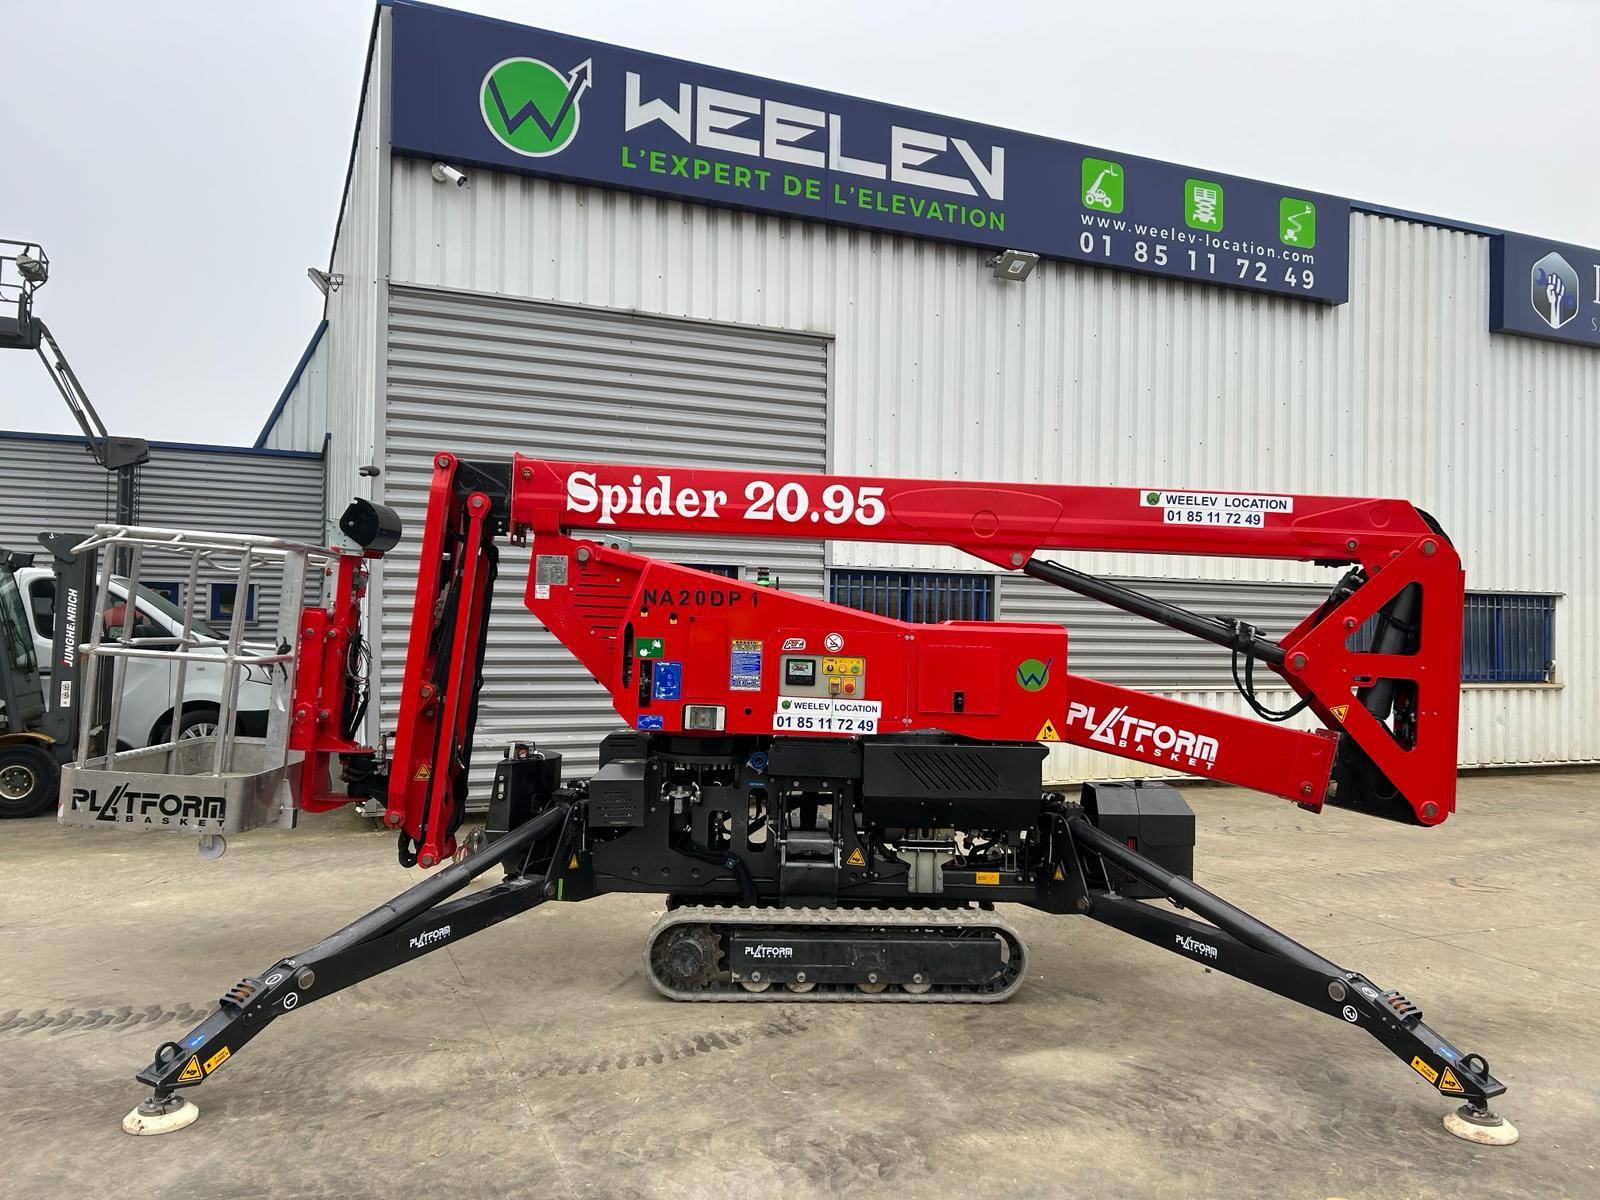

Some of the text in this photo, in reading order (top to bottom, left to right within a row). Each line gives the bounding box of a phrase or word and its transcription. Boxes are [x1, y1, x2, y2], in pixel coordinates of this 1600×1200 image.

[624, 70, 1005, 201] WEELEV
[783, 174, 821, 201] DE
[1080, 213, 1314, 265] www.weelev-location.com
[1079, 231, 1315, 290] 01 85 11 72 49
[566, 471, 886, 526] Spider 20.95
[1165, 494, 1219, 507] WEELEV
[1224, 497, 1288, 510] LOCATION
[1167, 510, 1261, 526] 01 85 11 72 49
[794, 702, 878, 714] WEELEV LOCATION
[776, 716, 874, 732] 01 85 11 72 49
[1065, 701, 1219, 762] PLATFORM
[1118, 740, 1215, 770] BASKET
[71, 782, 227, 821] PLATFORM
[125, 815, 225, 827] BASKET
[409, 925, 451, 949] PLATFORM
[1175, 934, 1218, 958] PLATFORM
[744, 943, 793, 958] PLATFORM
